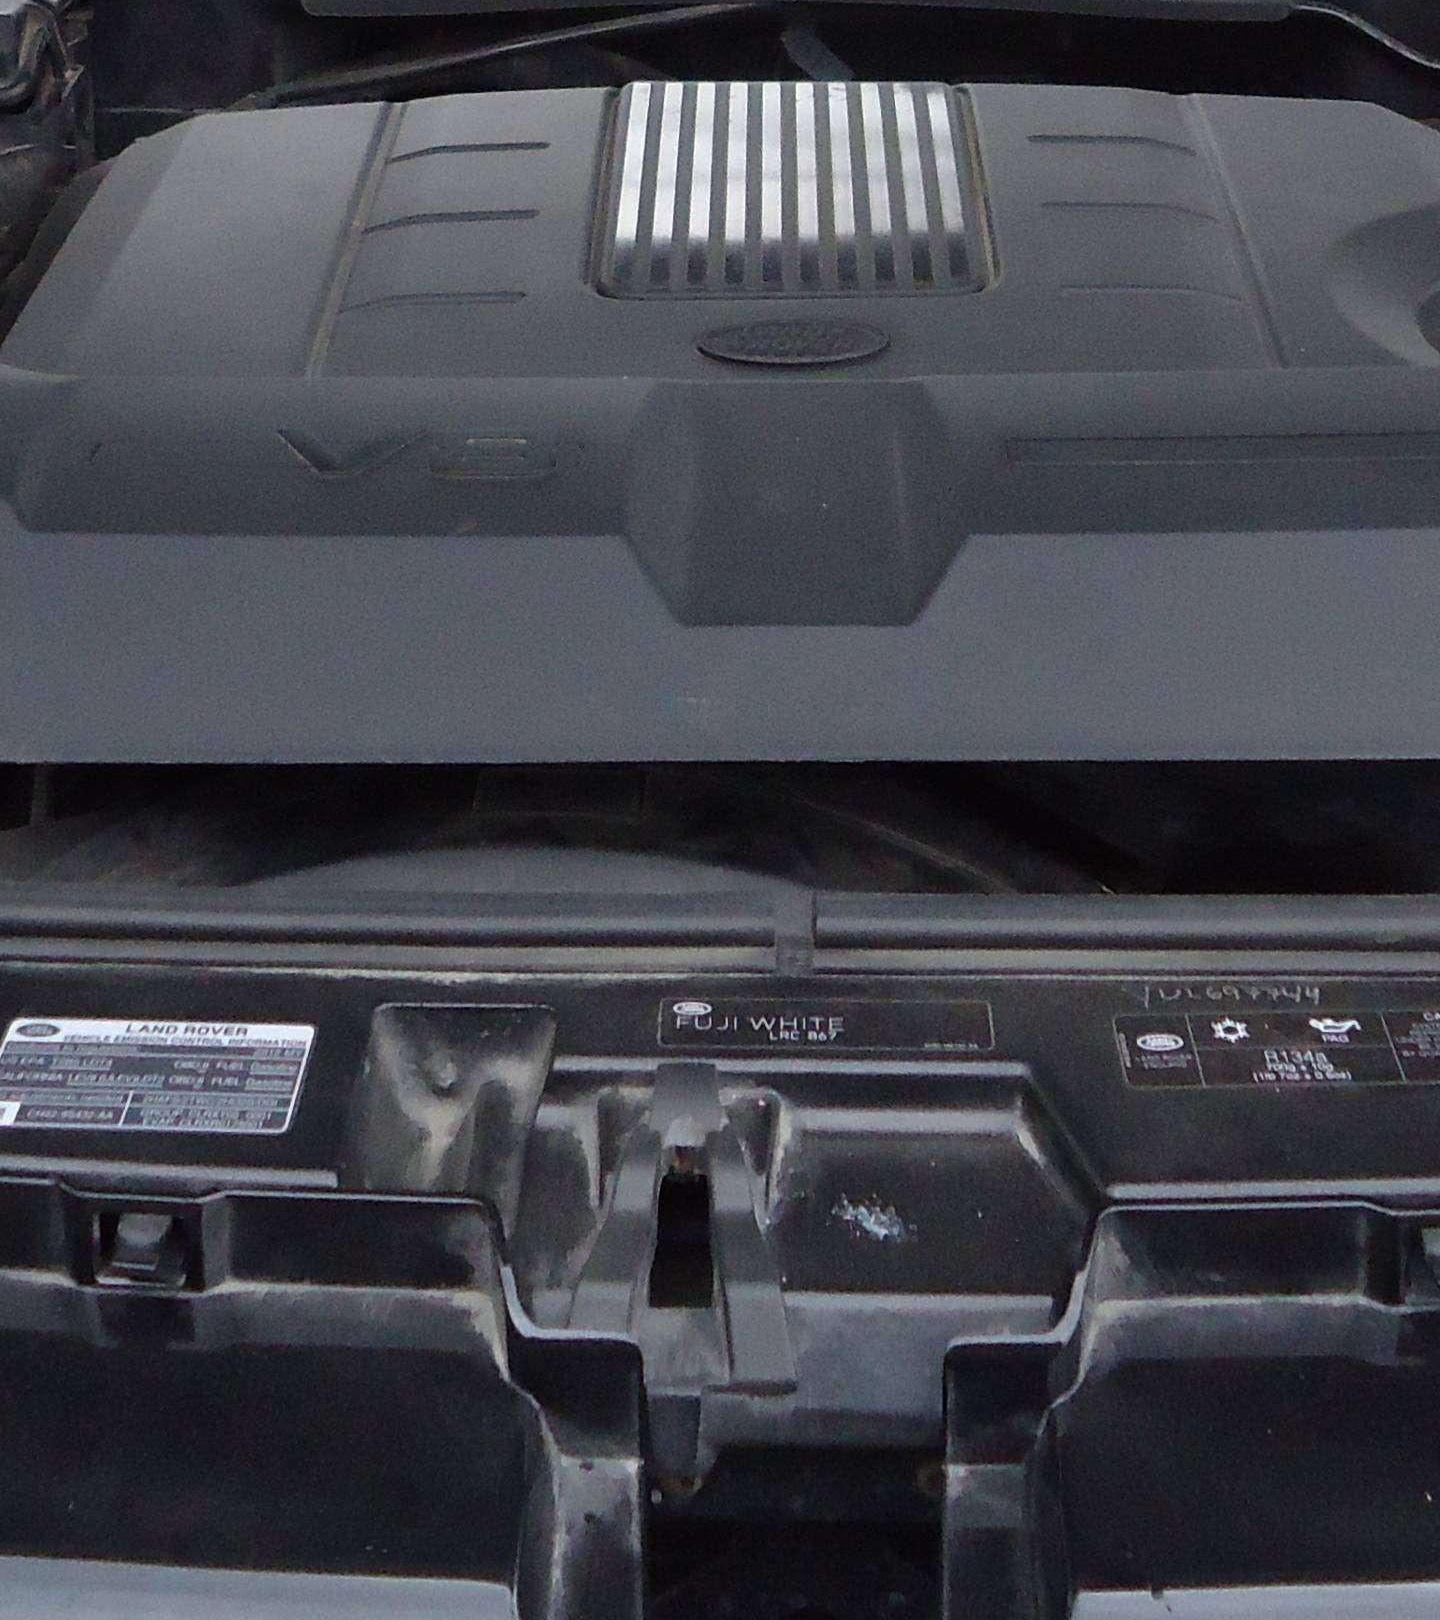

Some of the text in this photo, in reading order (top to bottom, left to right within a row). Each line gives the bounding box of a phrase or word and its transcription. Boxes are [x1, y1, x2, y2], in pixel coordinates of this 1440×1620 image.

[125, 1023, 249, 1036] LAND ROVER
[675, 1014, 845, 1032] FUJI WHITE
[768, 1030, 801, 1041] LRC
[227, 1038, 307, 1047] INFORMATION
[1263, 1049, 1328, 1064] R134a
